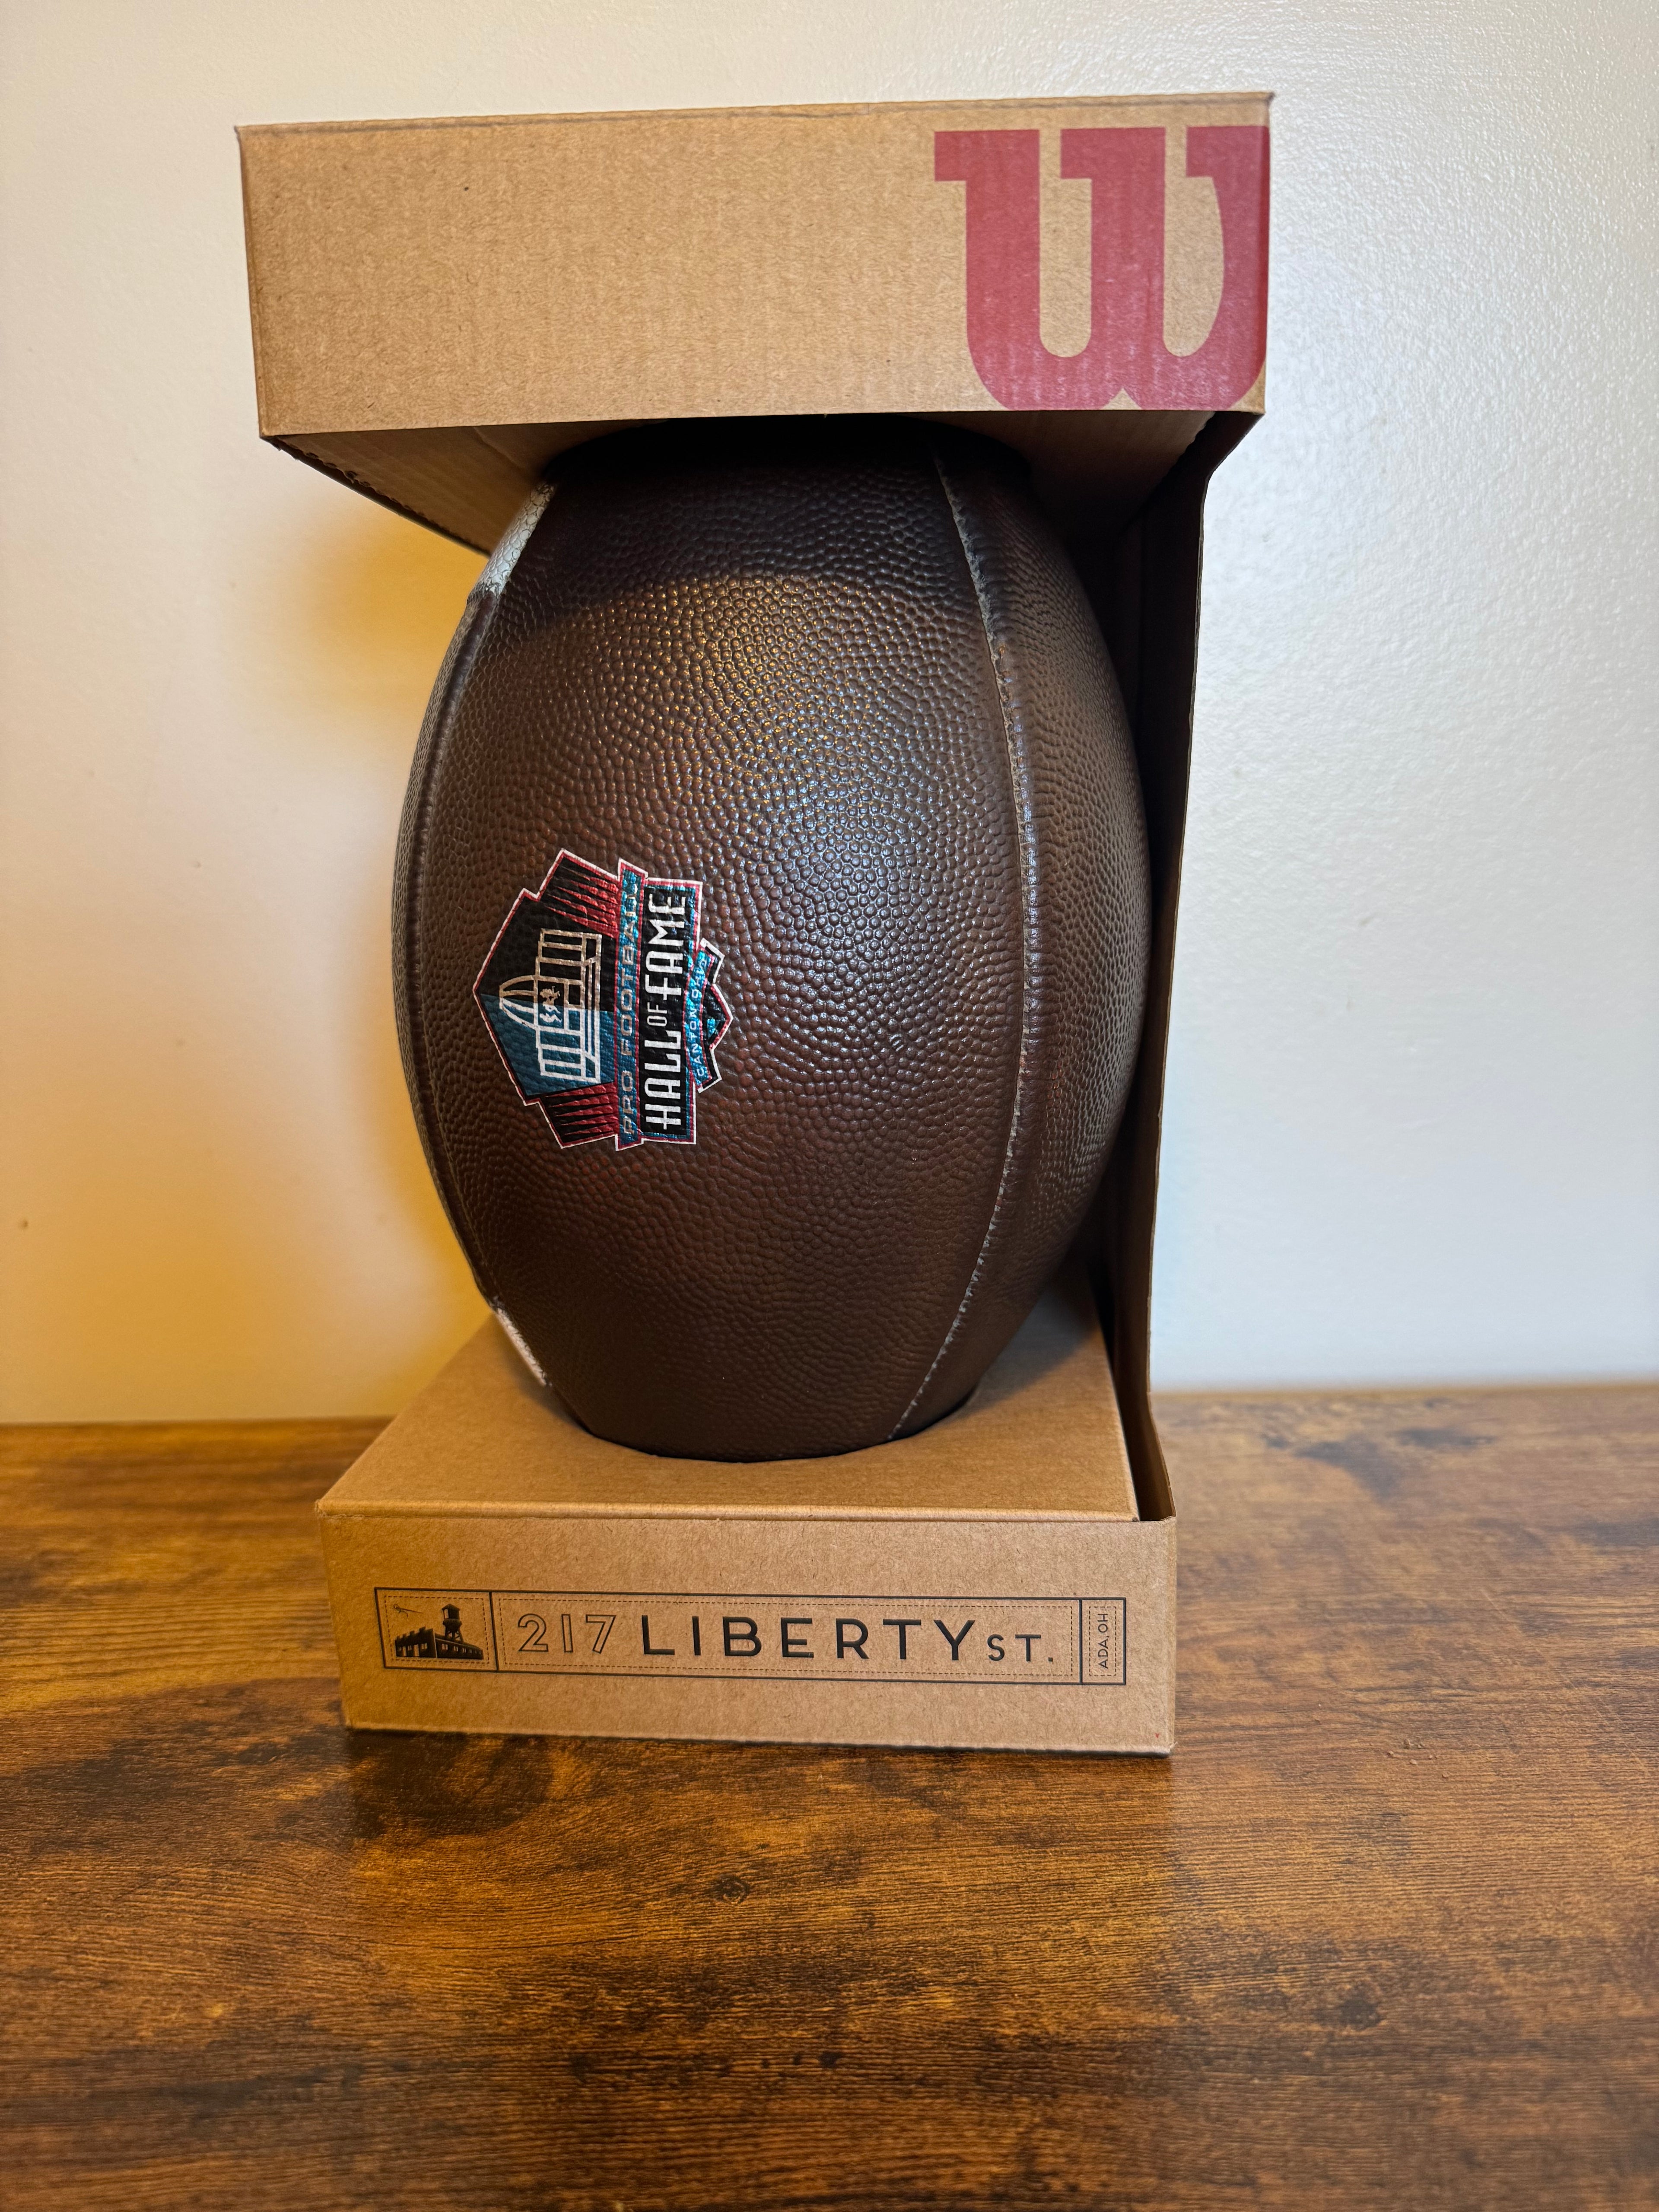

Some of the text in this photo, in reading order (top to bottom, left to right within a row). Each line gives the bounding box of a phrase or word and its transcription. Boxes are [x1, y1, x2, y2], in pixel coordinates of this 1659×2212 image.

[620, 883, 637, 1135] PRO FOOTBALL
[644, 894, 686, 1130] HALL OF FAME
[517, 1614, 1053, 1662] 217 LIBERTY ST.
[1098, 1613, 1109, 1670] ADA, OH
